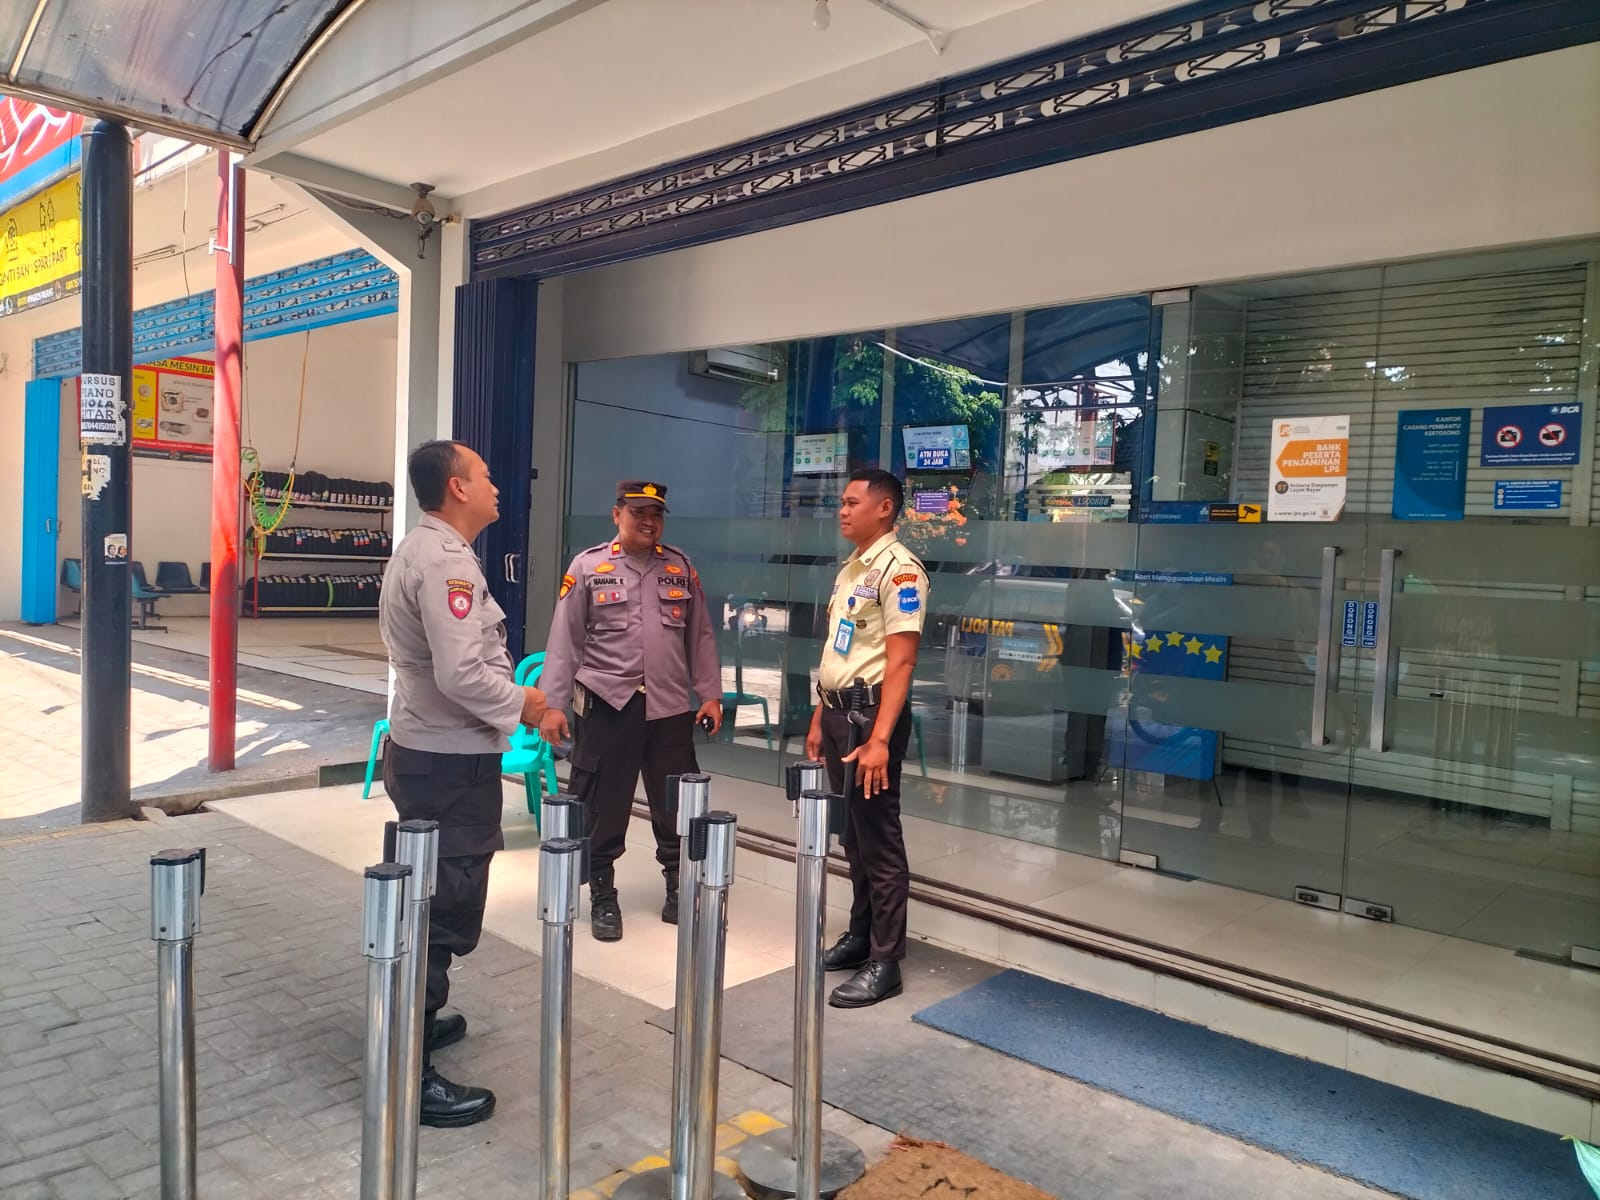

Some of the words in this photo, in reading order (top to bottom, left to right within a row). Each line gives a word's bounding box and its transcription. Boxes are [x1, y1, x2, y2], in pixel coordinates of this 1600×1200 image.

[170, 361, 200, 372] MESIN
[202, 365, 214, 374] BA
[1560, 406, 1580, 414] BCA
[1316, 443, 1342, 452] BANK
[932, 450, 949, 458] BUKA
[1302, 451, 1341, 460] PESERTA
[1282, 459, 1341, 467] PENJAMINAN
[1324, 465, 1340, 473] LPS
[657, 577, 685, 586] POLRI
[1152, 574, 1204, 583] Menggunakan
